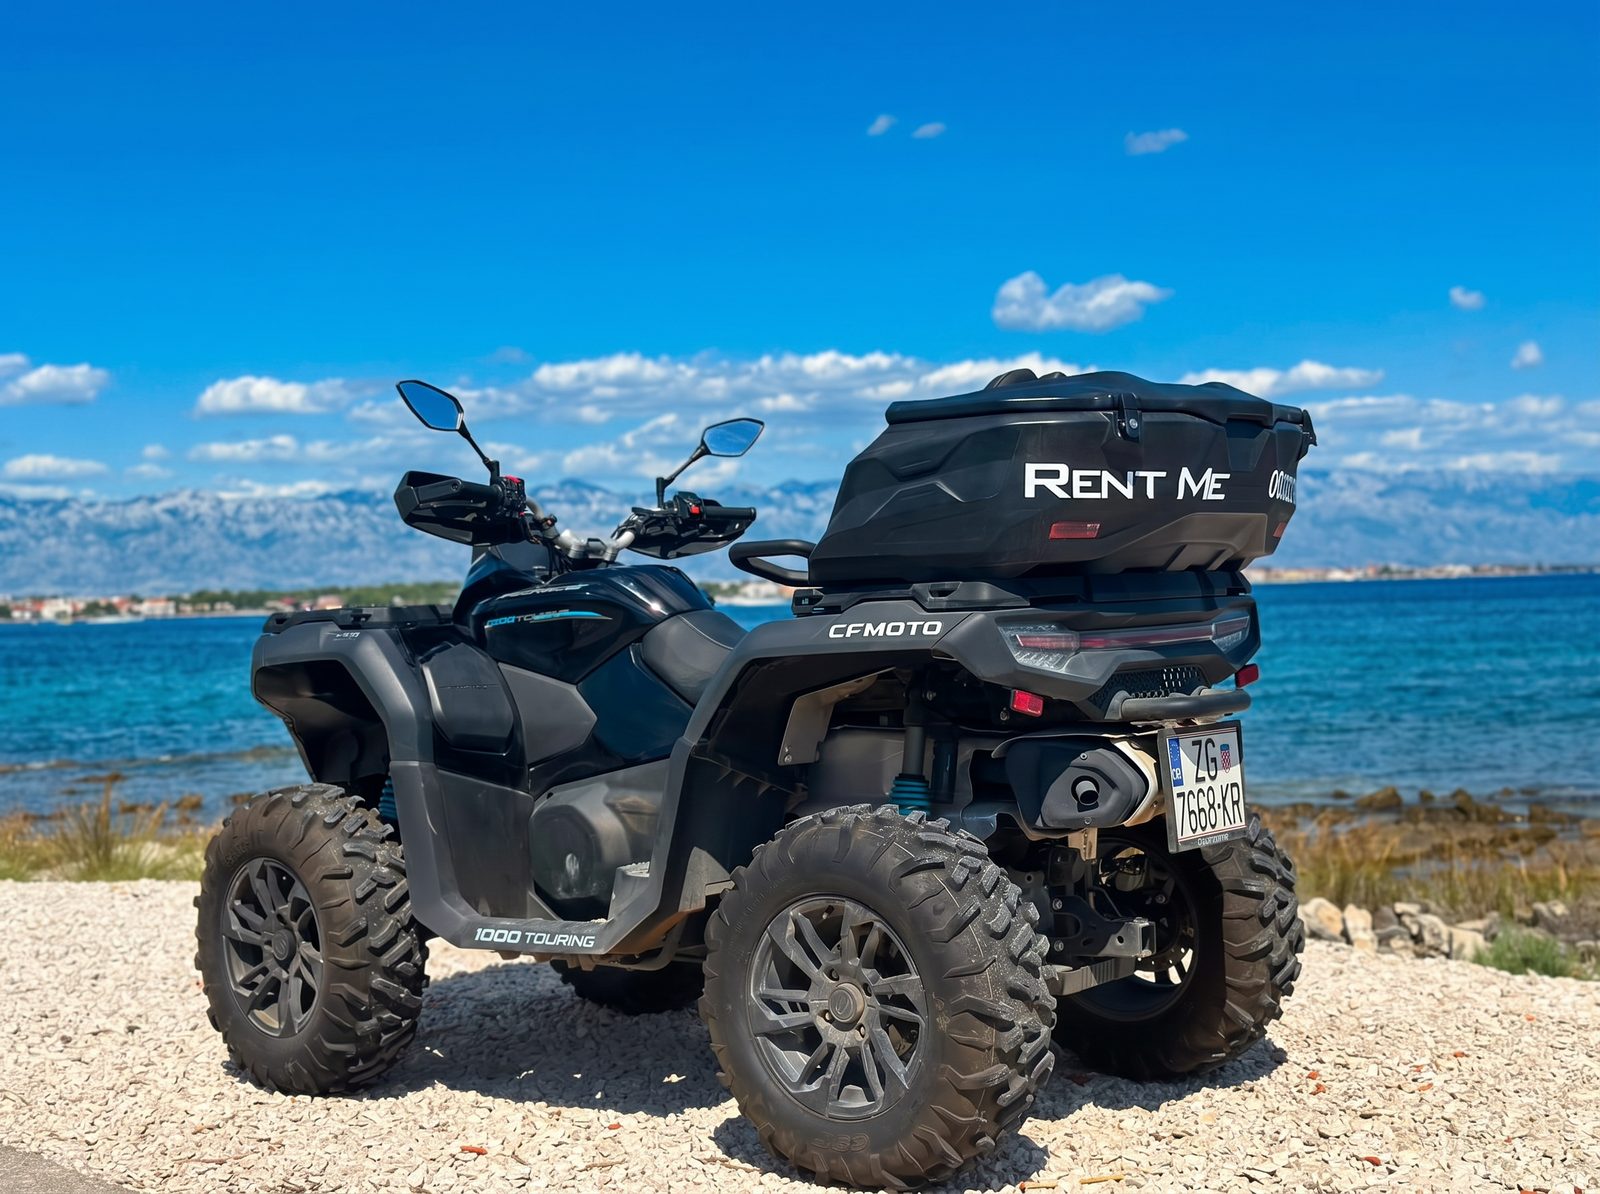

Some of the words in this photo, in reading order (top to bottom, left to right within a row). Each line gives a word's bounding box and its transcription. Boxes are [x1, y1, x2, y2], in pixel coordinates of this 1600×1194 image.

[1024, 462, 1167, 500] RENT
[1177, 466, 1231, 500] ME
[828, 620, 943, 639] CFMOTO
[1191, 737, 1219, 784] ZG
[474, 927, 522, 944] 1000
[524, 931, 596, 948] TOURING
